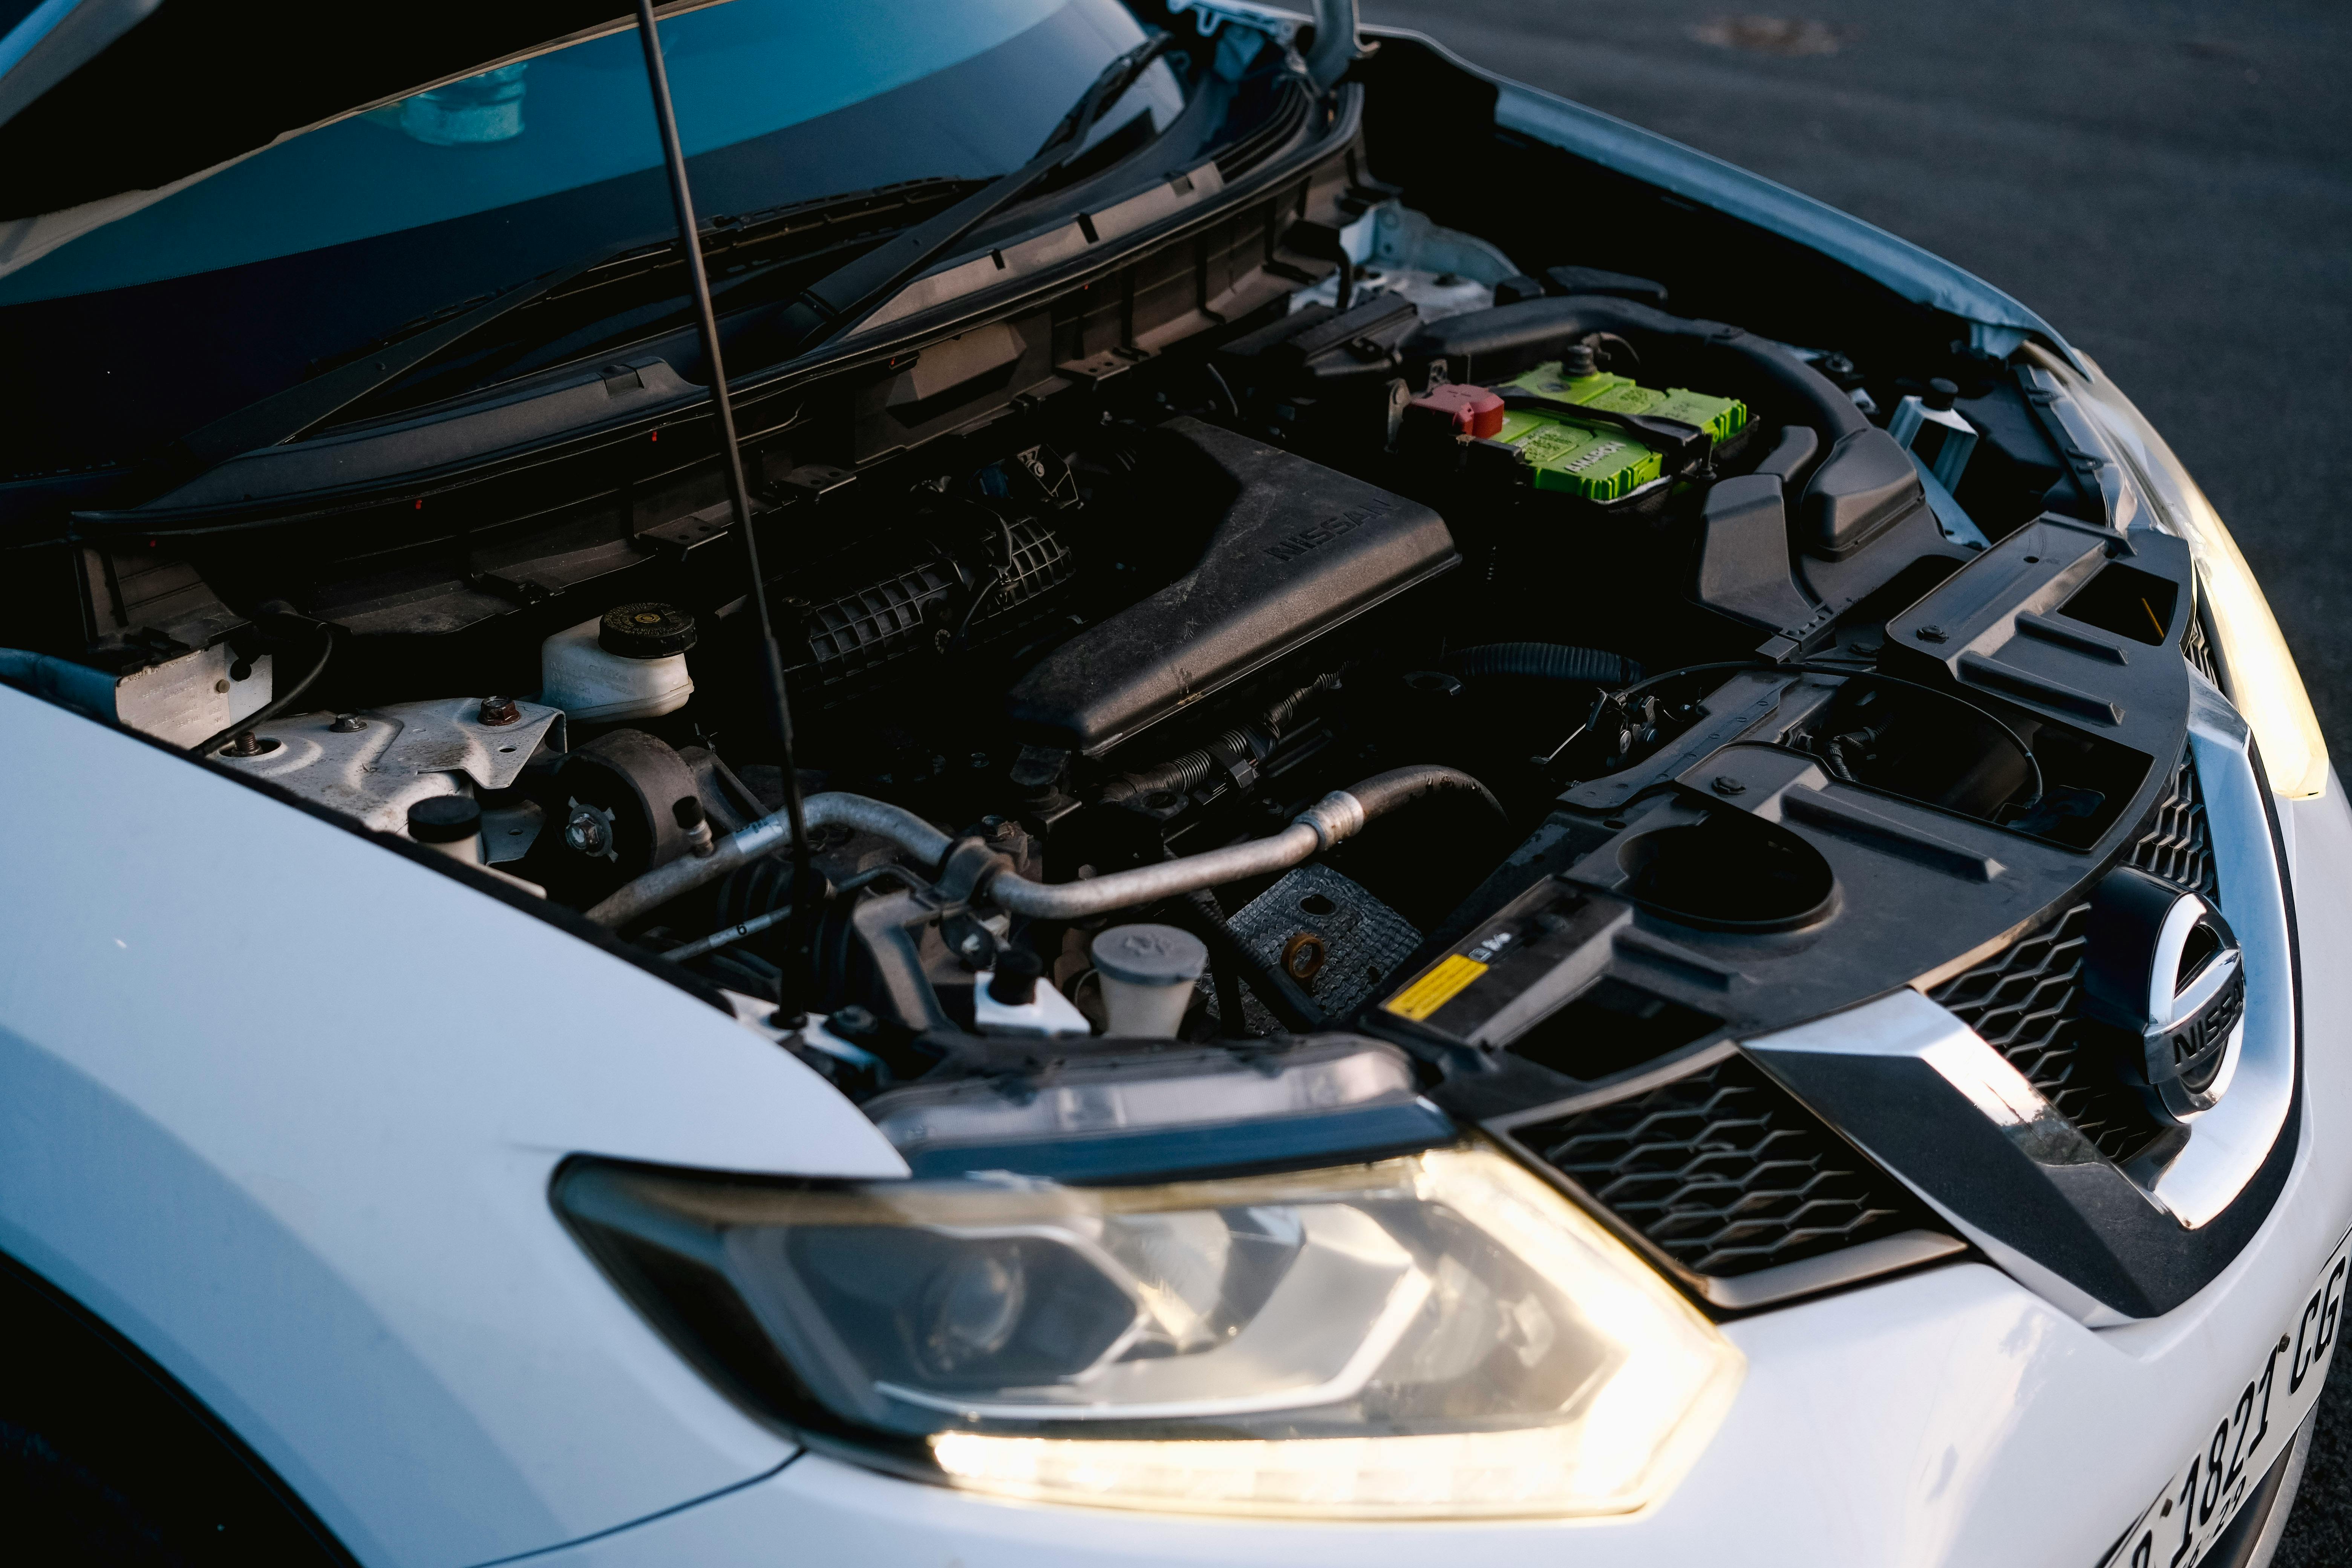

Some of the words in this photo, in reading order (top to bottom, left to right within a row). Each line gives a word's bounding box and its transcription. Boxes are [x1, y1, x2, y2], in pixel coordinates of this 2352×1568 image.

[1263, 498, 1392, 562] NISSAN
[736, 924, 747, 935] 6
[2172, 979, 2243, 1066] NISSA
[2170, 1344, 2278, 1568] 1821
[2290, 1256, 2346, 1394] CG
